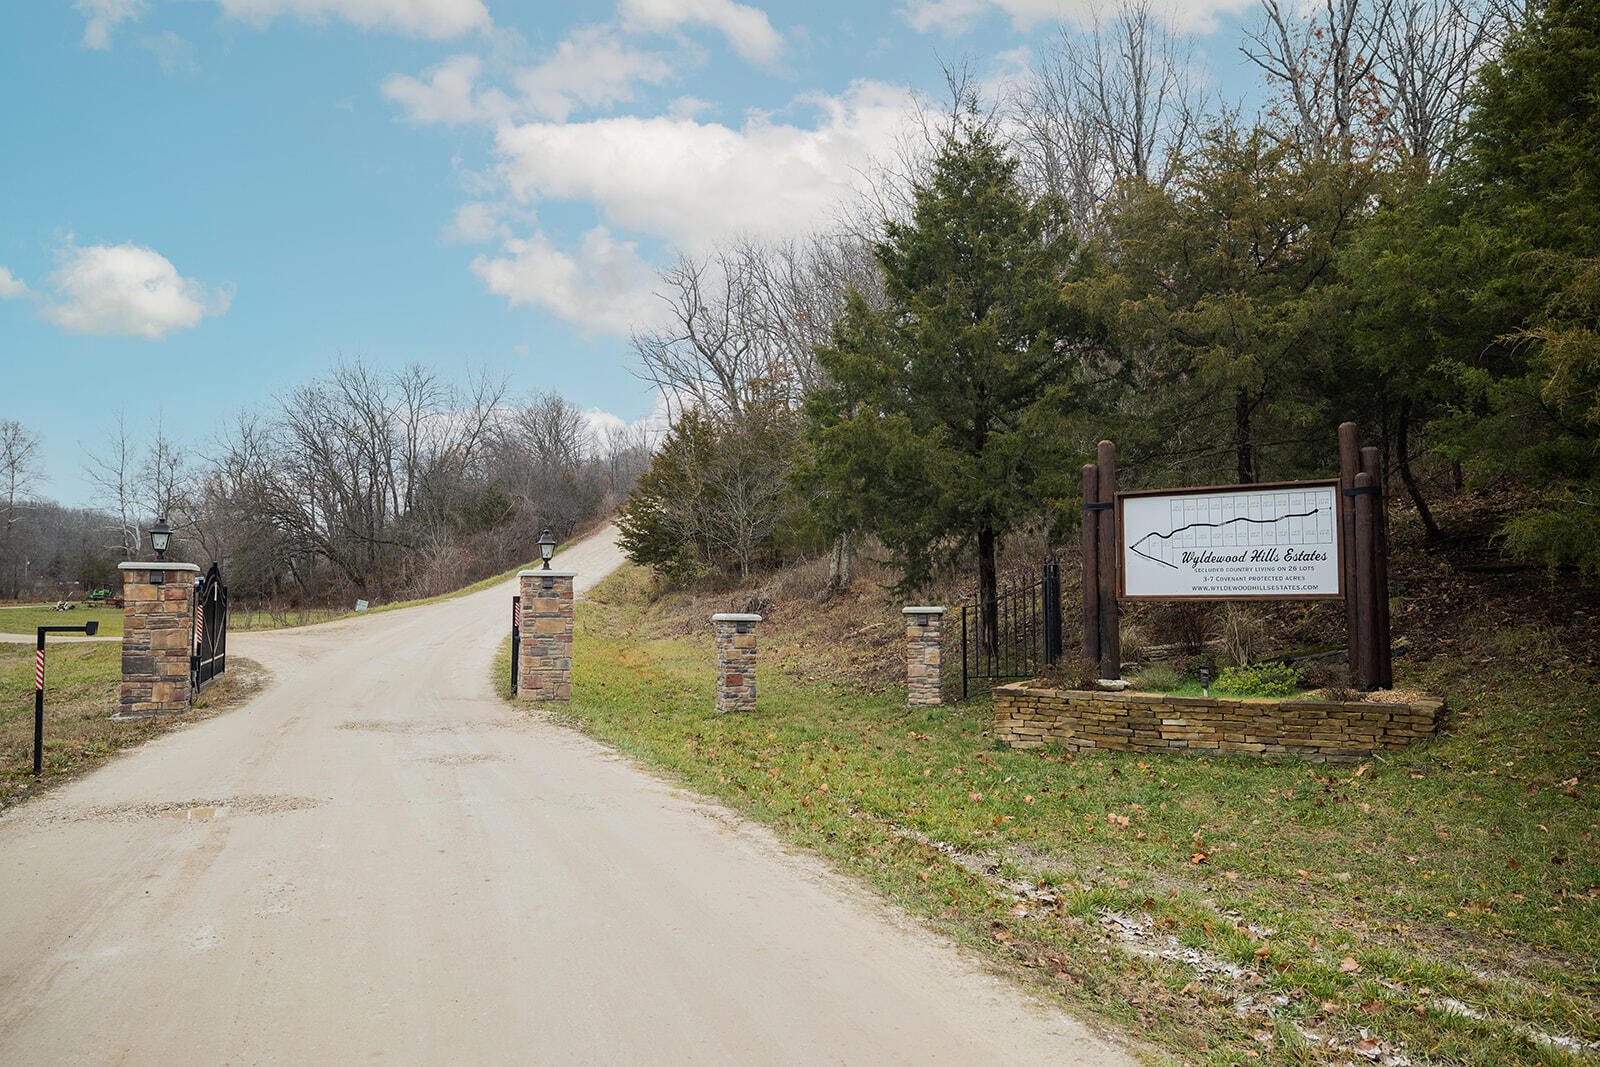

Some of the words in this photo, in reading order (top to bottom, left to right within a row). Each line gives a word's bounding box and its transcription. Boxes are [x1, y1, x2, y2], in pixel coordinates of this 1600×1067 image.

[1182, 550, 1248, 568] Wyldewood
[1250, 548, 1279, 562] Hills
[1283, 548, 1328, 562] Estates
